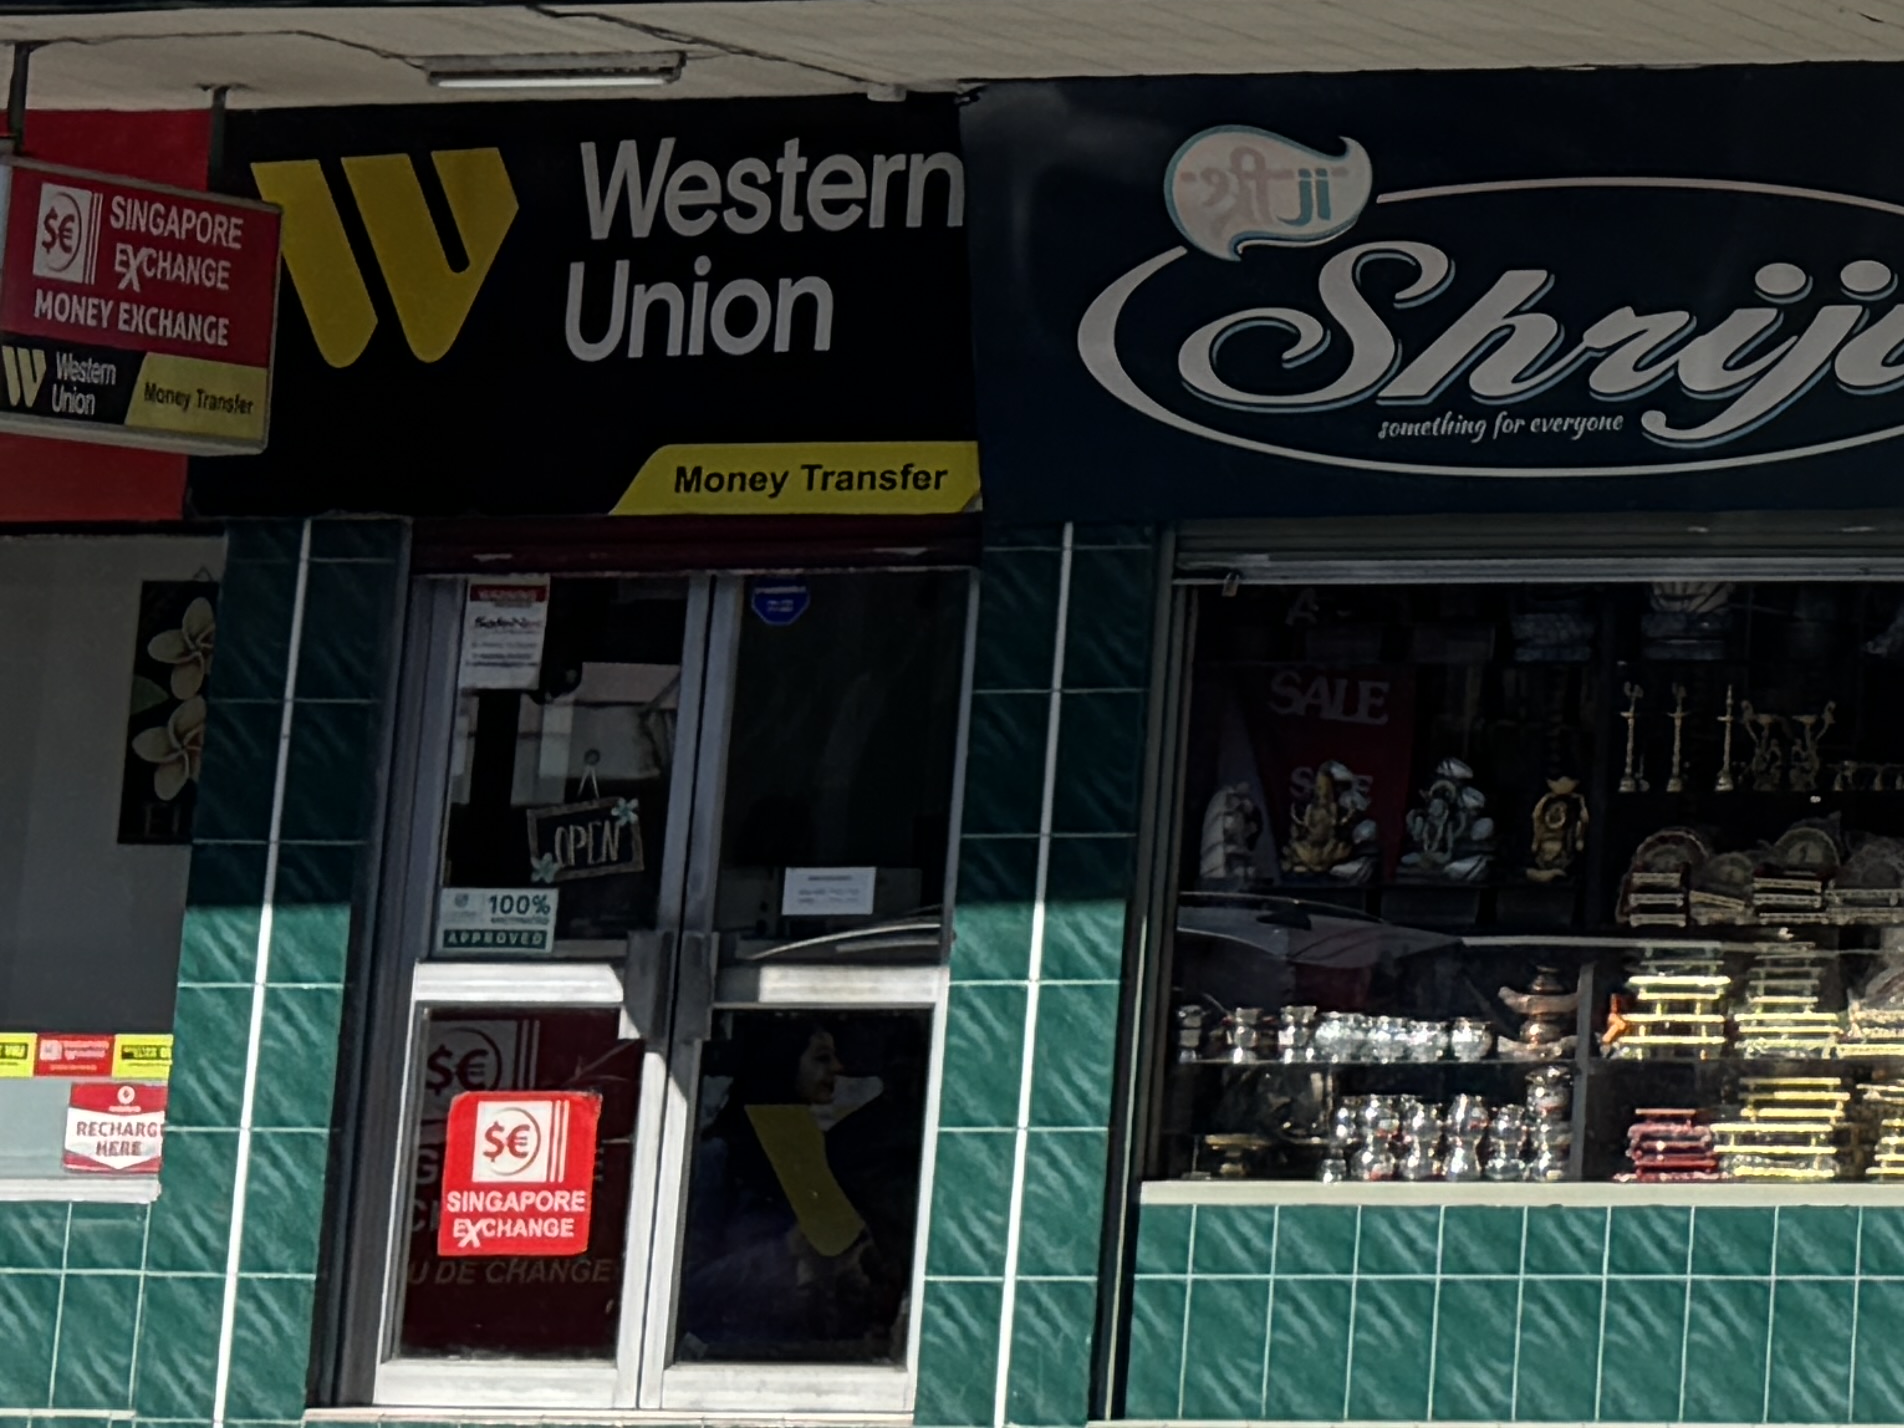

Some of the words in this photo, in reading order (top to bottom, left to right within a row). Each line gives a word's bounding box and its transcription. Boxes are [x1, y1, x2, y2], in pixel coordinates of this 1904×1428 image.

[580, 137, 964, 241] Western
[110, 195, 243, 249] SINGAPORE
[114, 243, 230, 292] EXCHANGE
[34, 289, 113, 328] MONEY
[118, 302, 229, 346] EXCHANGE
[565, 257, 834, 362] Union
[55, 351, 116, 385] Western
[52, 384, 95, 415] Union
[144, 381, 191, 413] Money
[196, 388, 254, 415] Transfer
[1377, 411, 1487, 444] something
[1492, 410, 1526, 440] for
[1530, 414, 1624, 441] everyone
[673, 461, 789, 497] Money
[805, 461, 949, 494] Transfer
[1268, 667, 1391, 726] SALE
[554, 819, 621, 868] OPEN
[489, 895, 550, 915] 100%
[449, 931, 545, 946] APPROVED
[76, 1121, 165, 1138] RECHARG
[95, 1141, 142, 1156] HERE
[447, 1190, 586, 1212] SINGAPORE
[453, 1217, 574, 1248] EXCHANGE
[434, 1260, 475, 1285] DE
[484, 1258, 613, 1285] CHANGE
